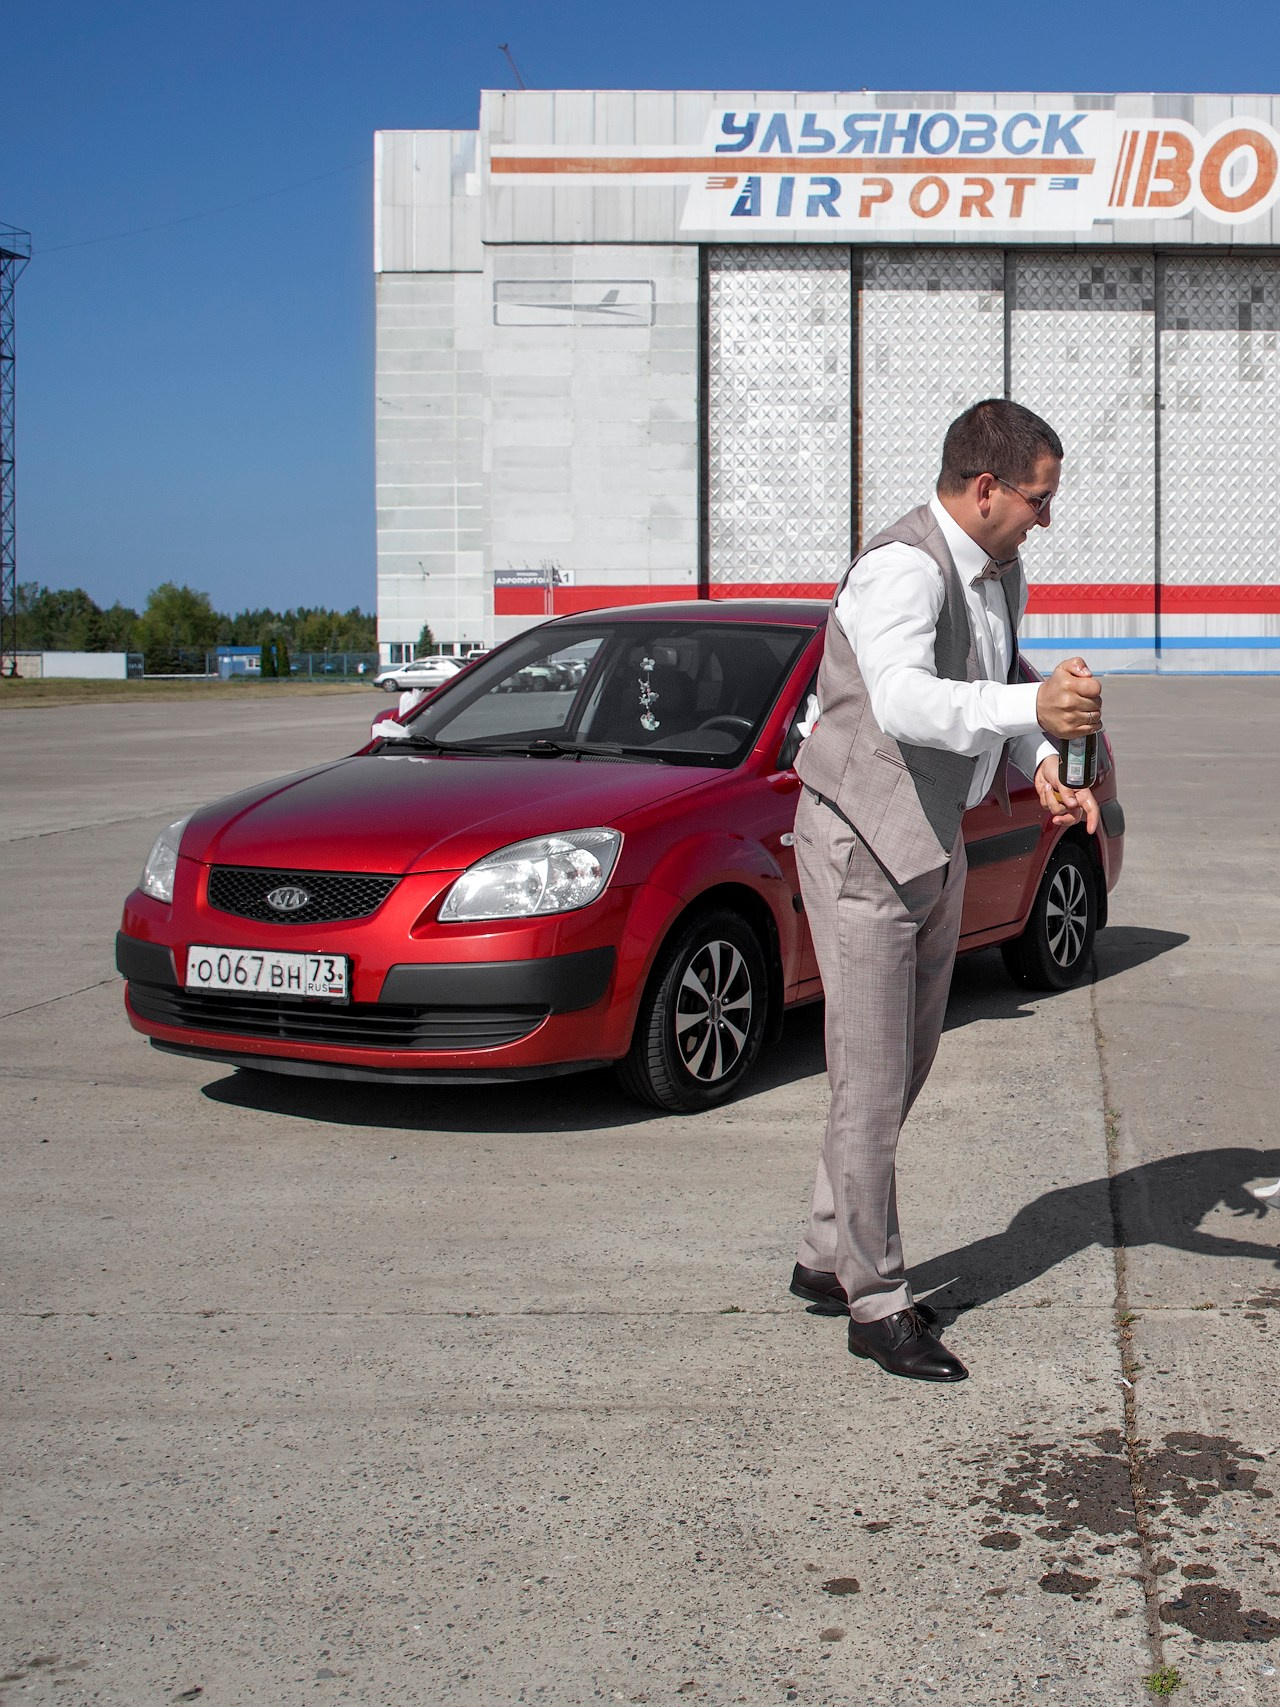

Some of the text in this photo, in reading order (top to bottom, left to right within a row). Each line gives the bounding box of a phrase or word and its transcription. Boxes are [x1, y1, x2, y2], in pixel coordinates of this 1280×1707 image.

[715, 112, 1089, 155] УЛЬЯНОВСК
[730, 175, 1036, 218] AIRPORT
[310, 959, 335, 983] 73
[308, 983, 328, 993] RUS
